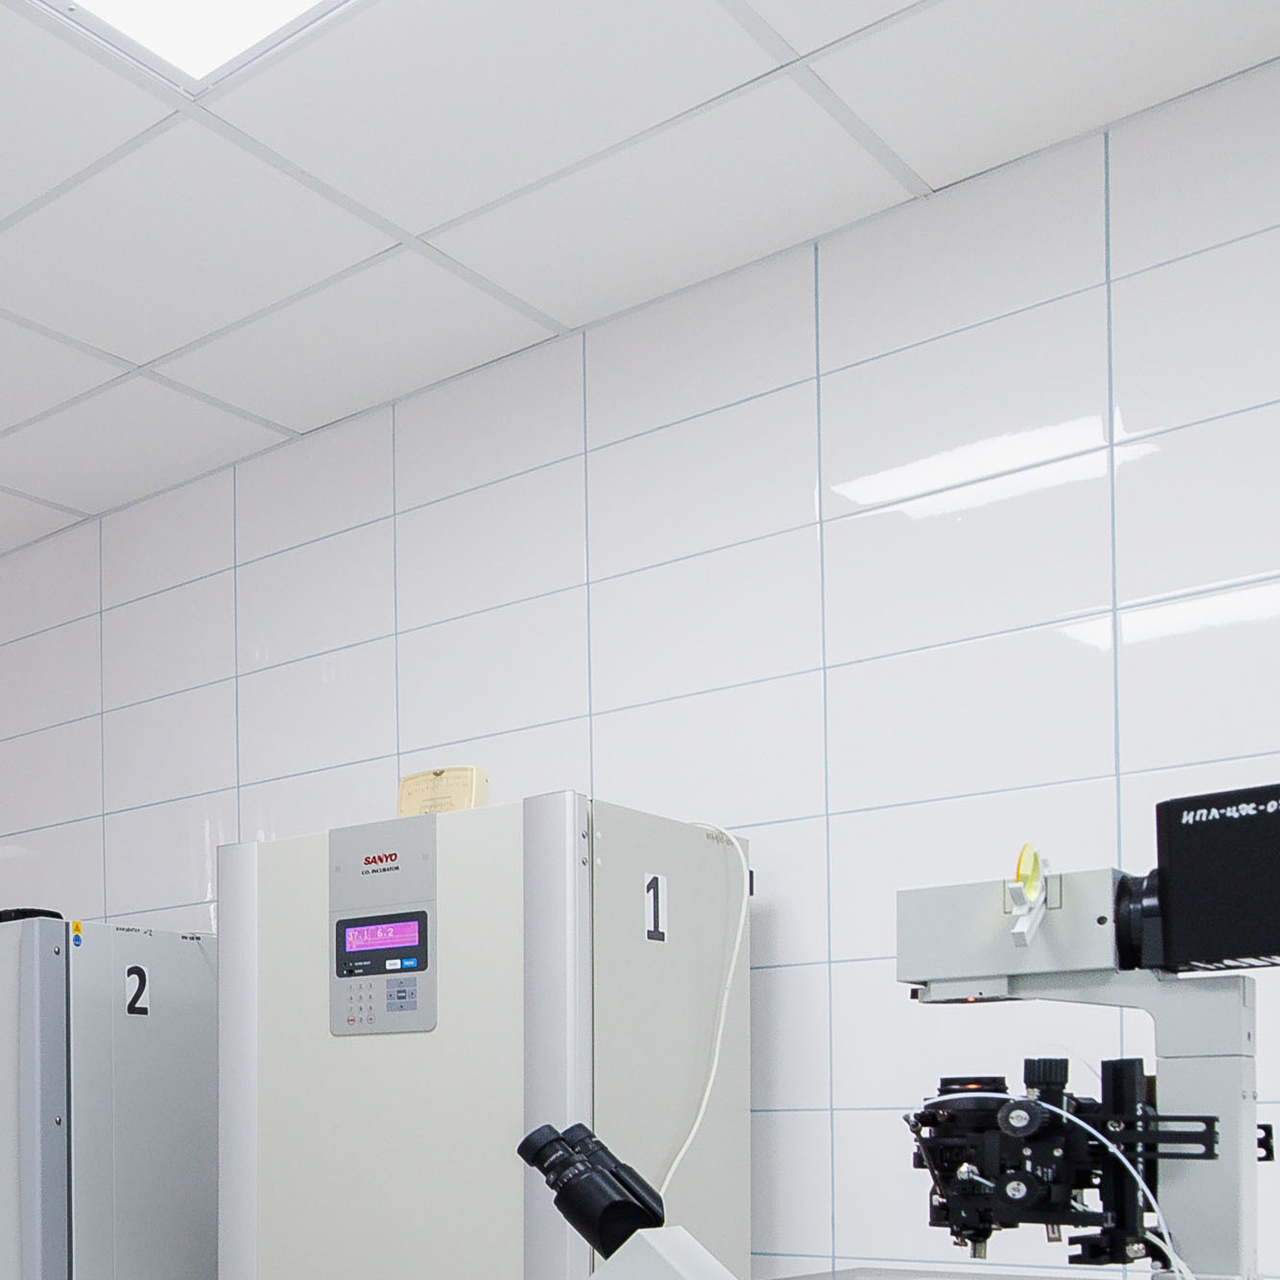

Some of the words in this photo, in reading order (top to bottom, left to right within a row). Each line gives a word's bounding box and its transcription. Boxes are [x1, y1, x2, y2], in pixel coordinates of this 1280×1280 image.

[363, 852, 398, 866] SANYO
[371, 865, 400, 874] INCUBATOR
[646, 876, 665, 941] 1
[347, 930, 369, 941] 37.1
[376, 927, 394, 938] 6.2
[127, 966, 148, 1015] 2
